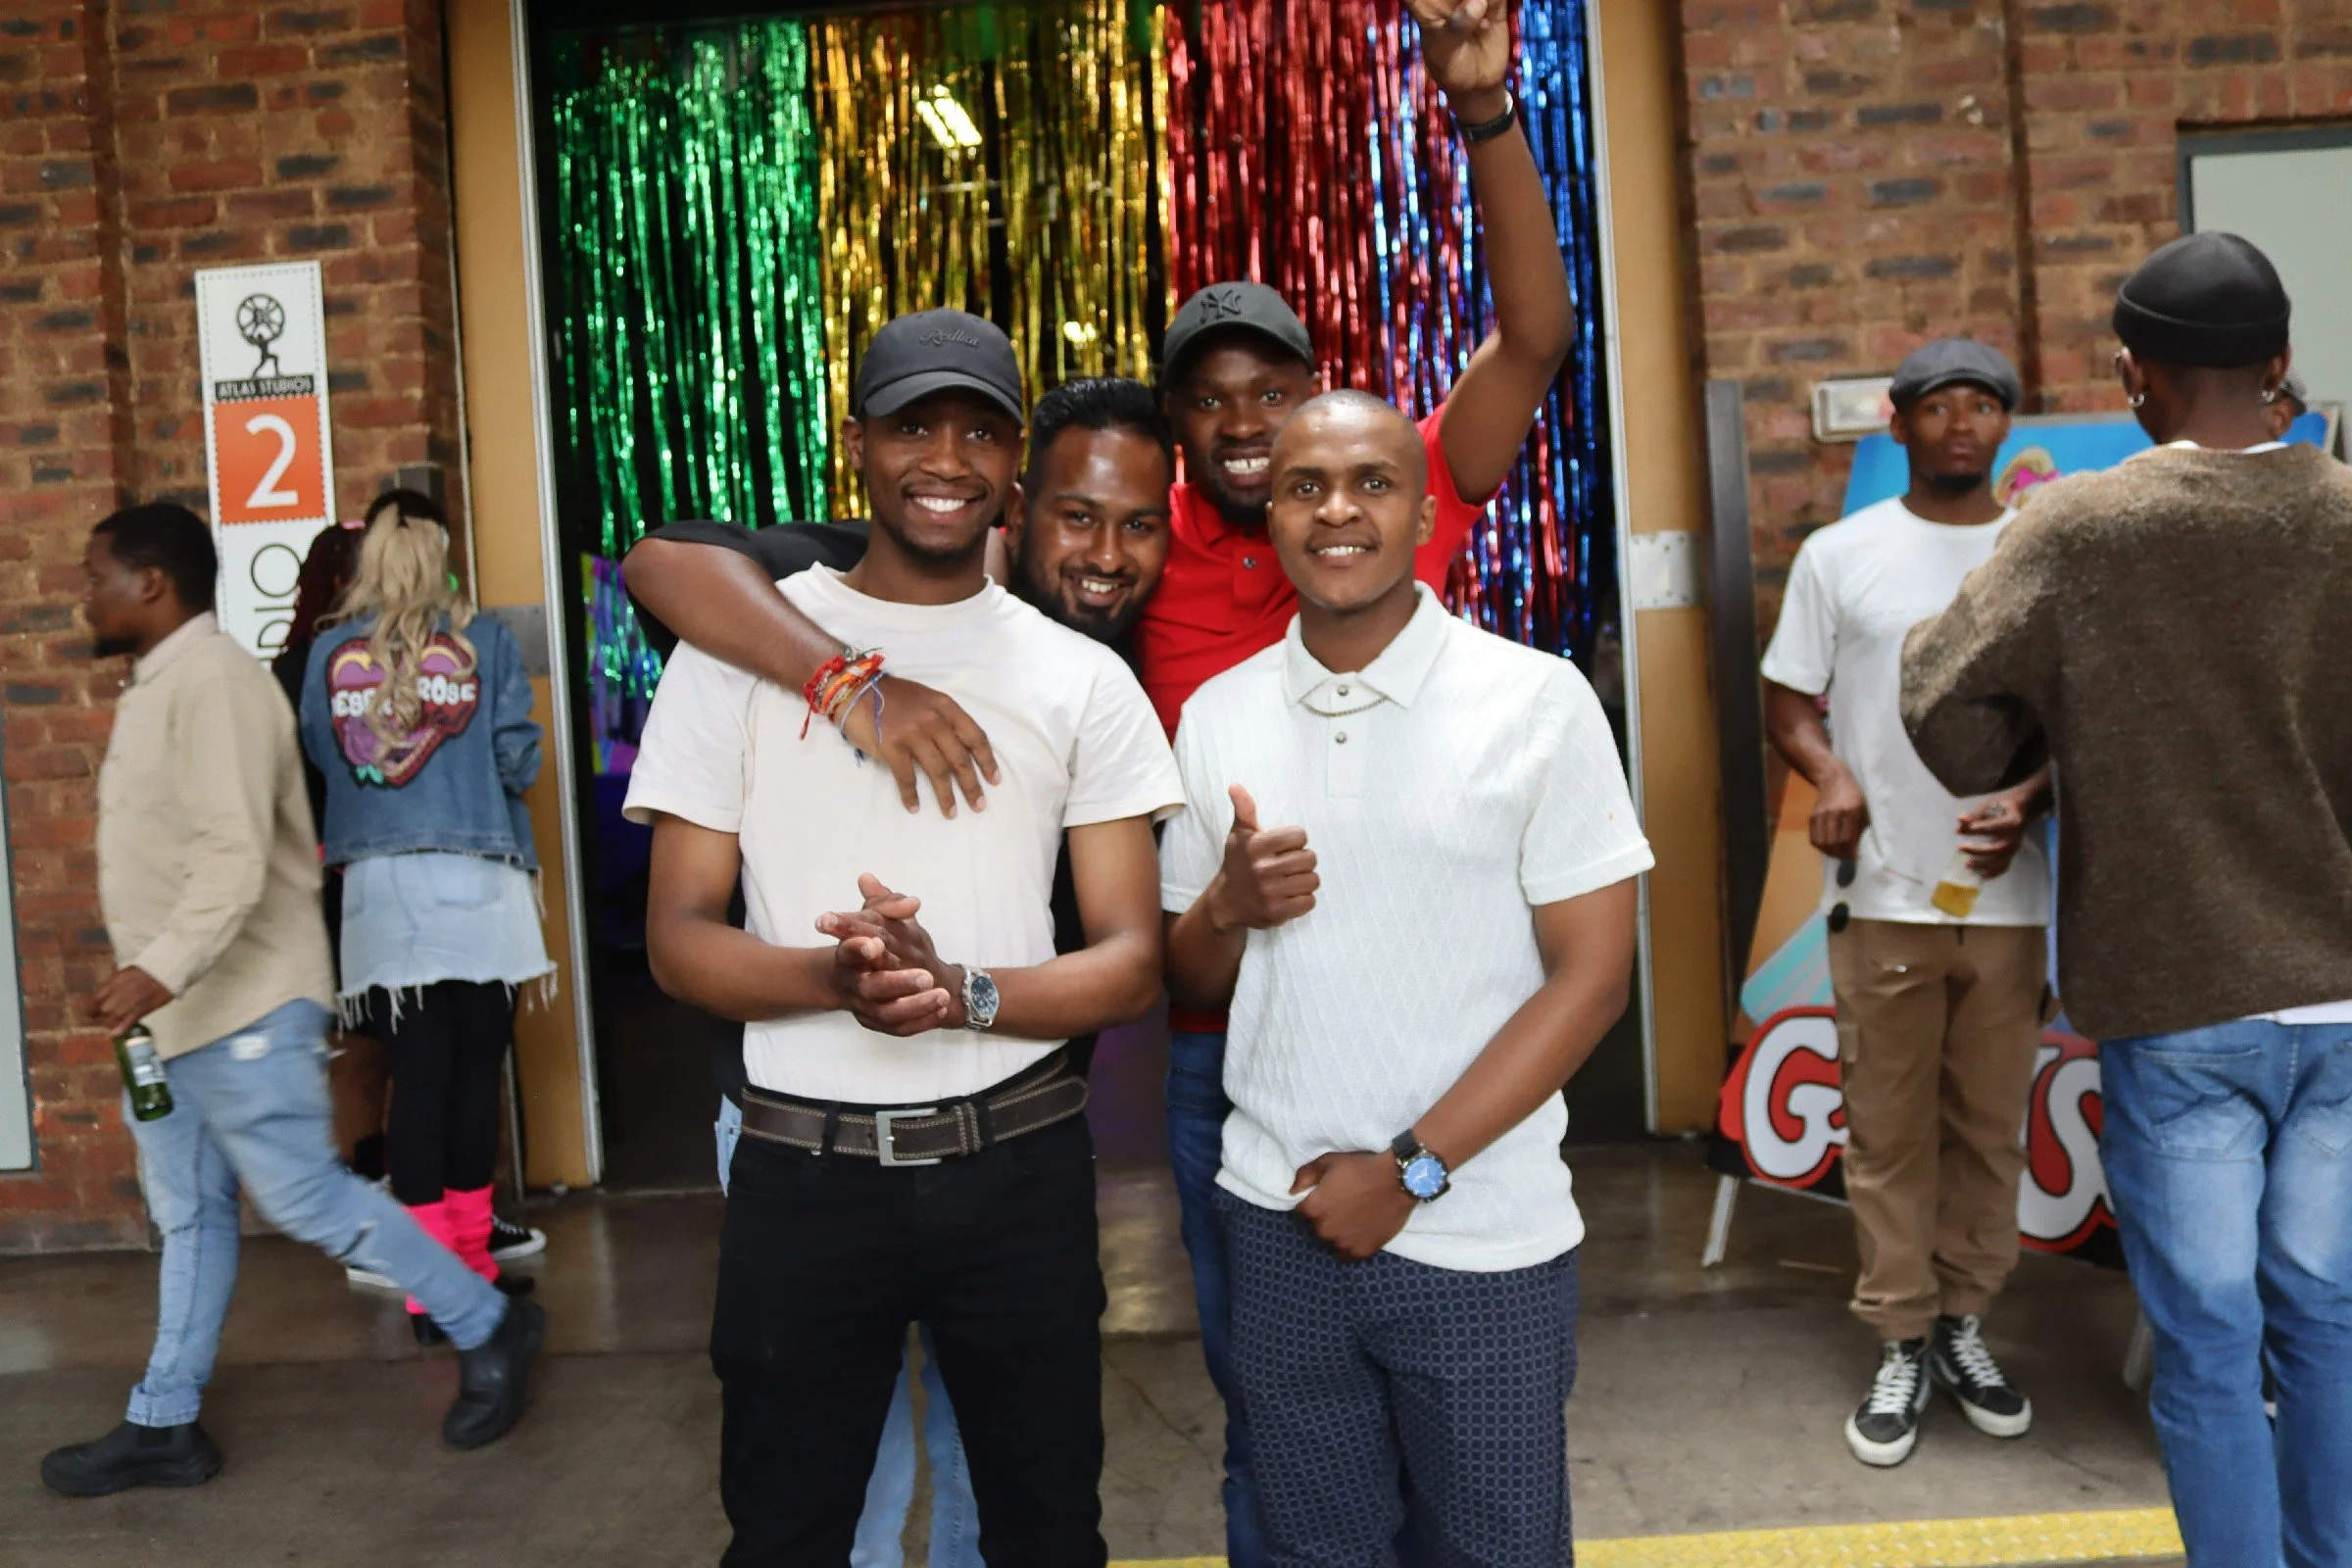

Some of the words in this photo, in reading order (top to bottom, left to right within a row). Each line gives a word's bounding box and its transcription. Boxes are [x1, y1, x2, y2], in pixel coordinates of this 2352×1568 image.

[1200, 289, 1242, 324] NY
[218, 380, 257, 399] ATLAS
[258, 375, 313, 395] STUDIOS
[245, 413, 299, 509] 2
